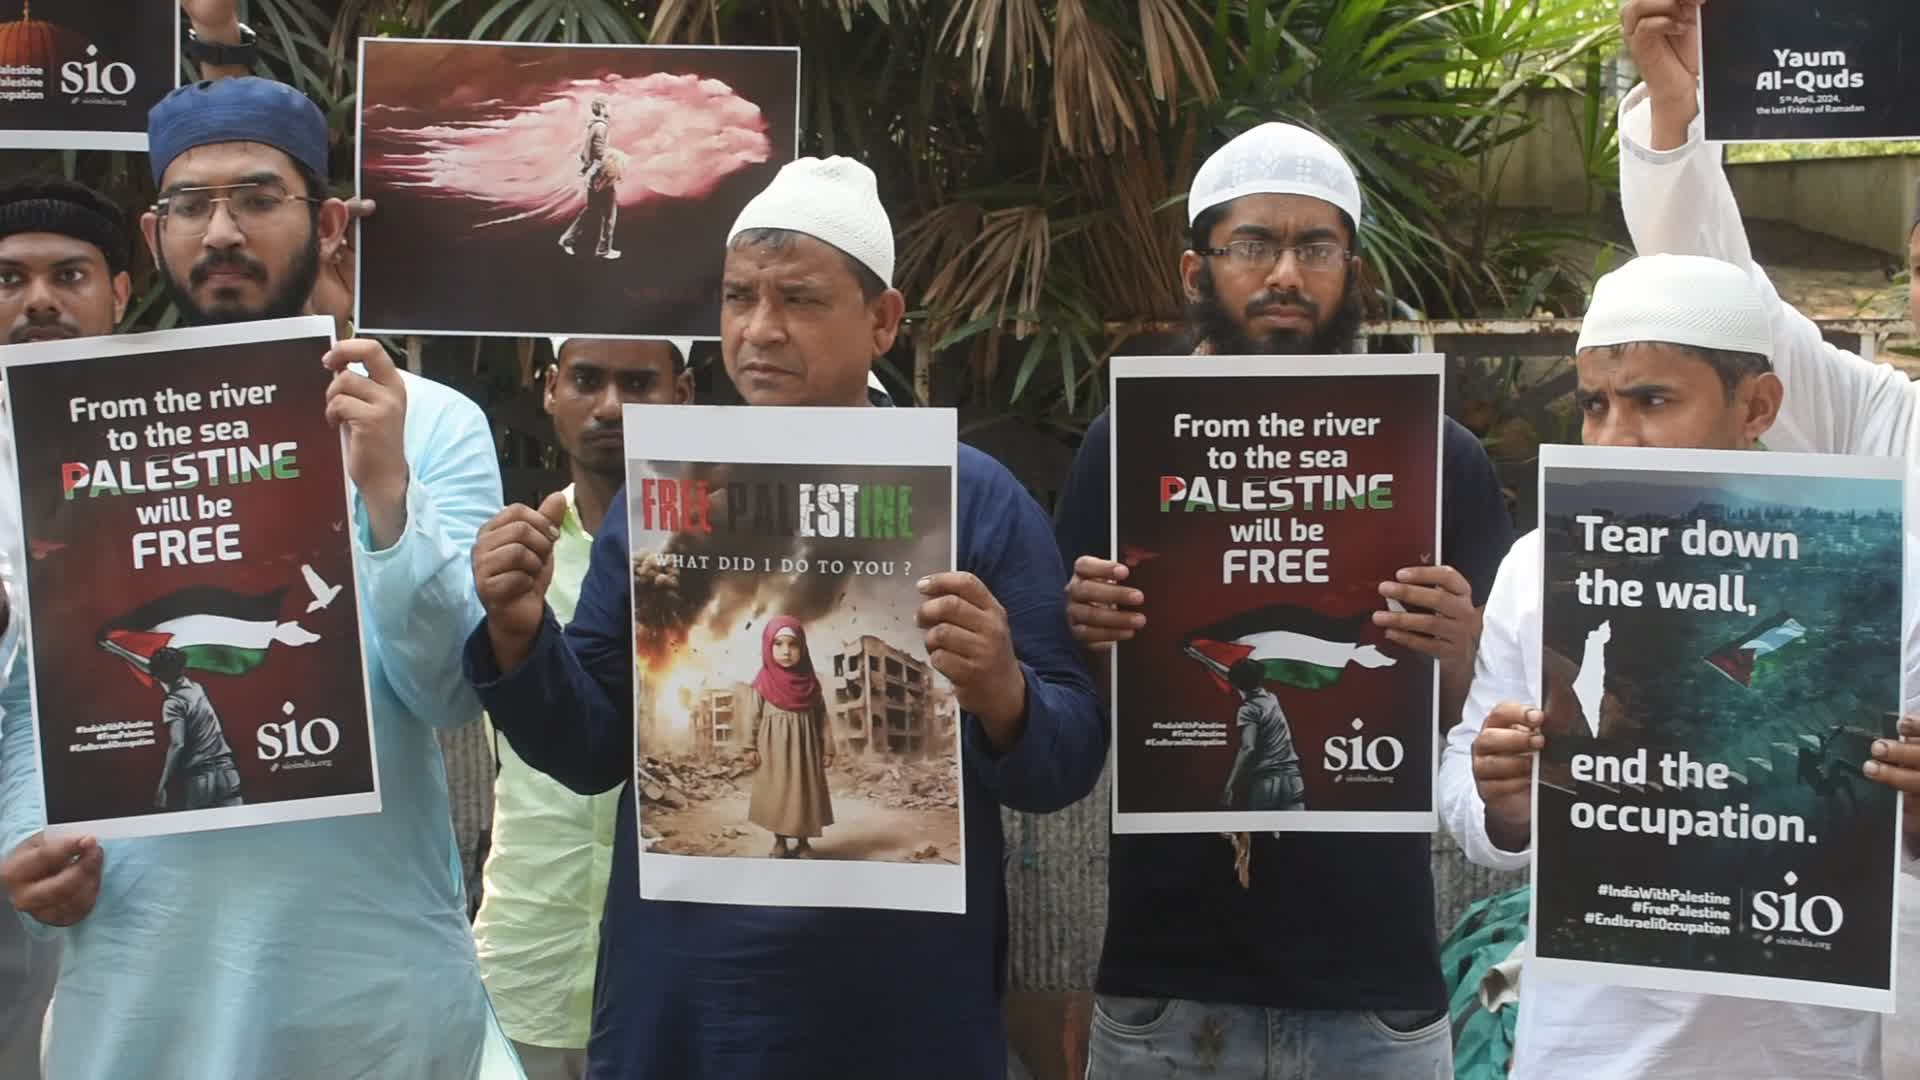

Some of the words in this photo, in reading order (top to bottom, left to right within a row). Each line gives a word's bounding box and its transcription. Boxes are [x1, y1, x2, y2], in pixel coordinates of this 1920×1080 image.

[61, 44, 136, 95] sio
[1773, 49, 1846, 68] Yaum
[1756, 69, 1864, 93] Al-Quds
[1756, 107, 1770, 115] the
[1772, 106, 1786, 114] last
[1788, 105, 1813, 115] Friday
[1815, 105, 1824, 114] of
[1825, 104, 1865, 113] Ramadan
[69, 397, 147, 423] From
[154, 387, 201, 414] the
[209, 382, 277, 409] river
[107, 428, 137, 451] to
[145, 421, 192, 448] the
[200, 419, 249, 443] sea
[1174, 413, 1249, 438] From
[1258, 413, 1304, 437] the
[1313, 412, 1381, 437] river
[62, 442, 300, 500] PALESTINE
[1207, 446, 1237, 469] to
[1244, 444, 1291, 469] the
[1300, 449, 1348, 468] sea
[136, 496, 190, 525] will
[197, 494, 233, 519] be
[641, 477, 712, 535] FREE
[727, 482, 915, 541] PALESTINE
[1160, 474, 1393, 513] PALESTINE
[132, 524, 242, 570] FREE
[1230, 518, 1282, 542] will
[1290, 517, 1325, 542] be
[1576, 515, 1669, 554] Tear
[1681, 519, 1798, 560] down
[655, 553, 709, 569] WHAT
[719, 556, 755, 570] DID
[764, 557, 771, 572] I
[781, 559, 809, 574] DO
[817, 560, 844, 575] TO
[853, 560, 895, 576] YOU
[904, 561, 912, 576] ?
[1223, 549, 1330, 584] FREE
[1575, 568, 1643, 607] the
[1656, 574, 1757, 616] wall,
[256, 701, 340, 760] sio
[1323, 717, 1404, 772] sio
[1571, 748, 1647, 785] end
[1659, 751, 1729, 789] the
[1570, 802, 1817, 845] occupation.
[1597, 884, 1731, 905] #IndiaWithPalestine
[1631, 902, 1731, 921] #FreePalestine
[1751, 871, 1844, 936] sio
[1584, 913, 1731, 936] #EndIsraeliOccupation
